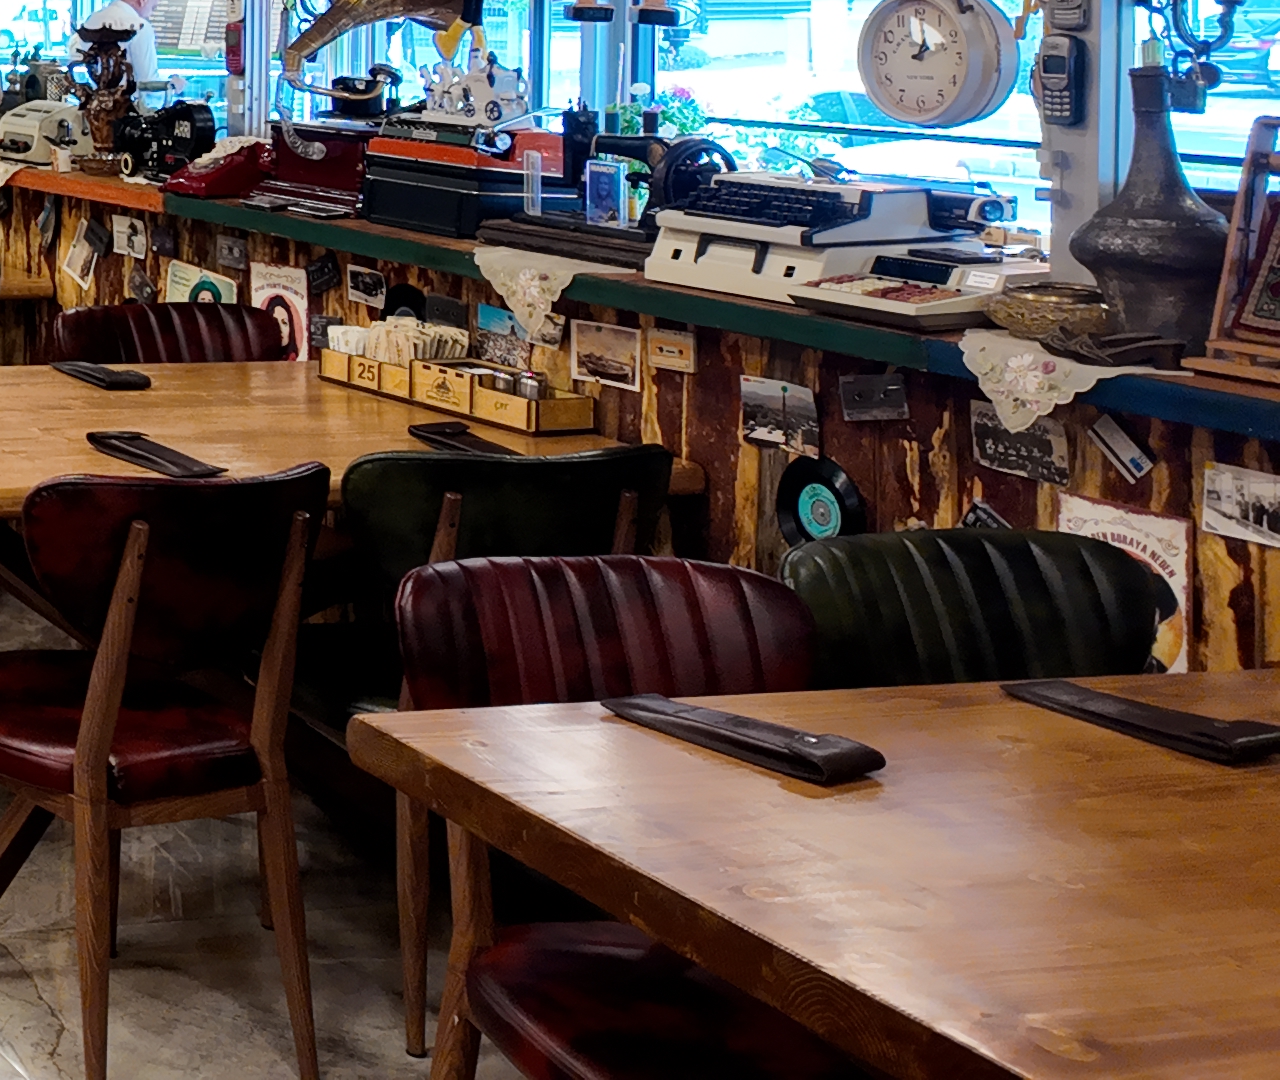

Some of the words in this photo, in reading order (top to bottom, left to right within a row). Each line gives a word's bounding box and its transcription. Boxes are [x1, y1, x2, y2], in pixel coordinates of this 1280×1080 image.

[896, 14, 906, 28] 11
[914, 6, 926, 22] 12
[937, 14, 942, 28] 1
[883, 29, 895, 44] 10
[948, 29, 958, 44] 2
[878, 51, 888, 66] 9
[954, 51, 963, 67] 3
[884, 72, 893, 88] 8
[948, 74, 958, 88] 4
[898, 88, 906, 103] 7
[915, 94, 926, 109] 6
[935, 88, 945, 105] 5
[174, 120, 191, 138] ARRI
[357, 362, 376, 382] 25
[1110, 531, 1148, 555] BURAYA
[1148, 549, 1177, 579] NEDEN
